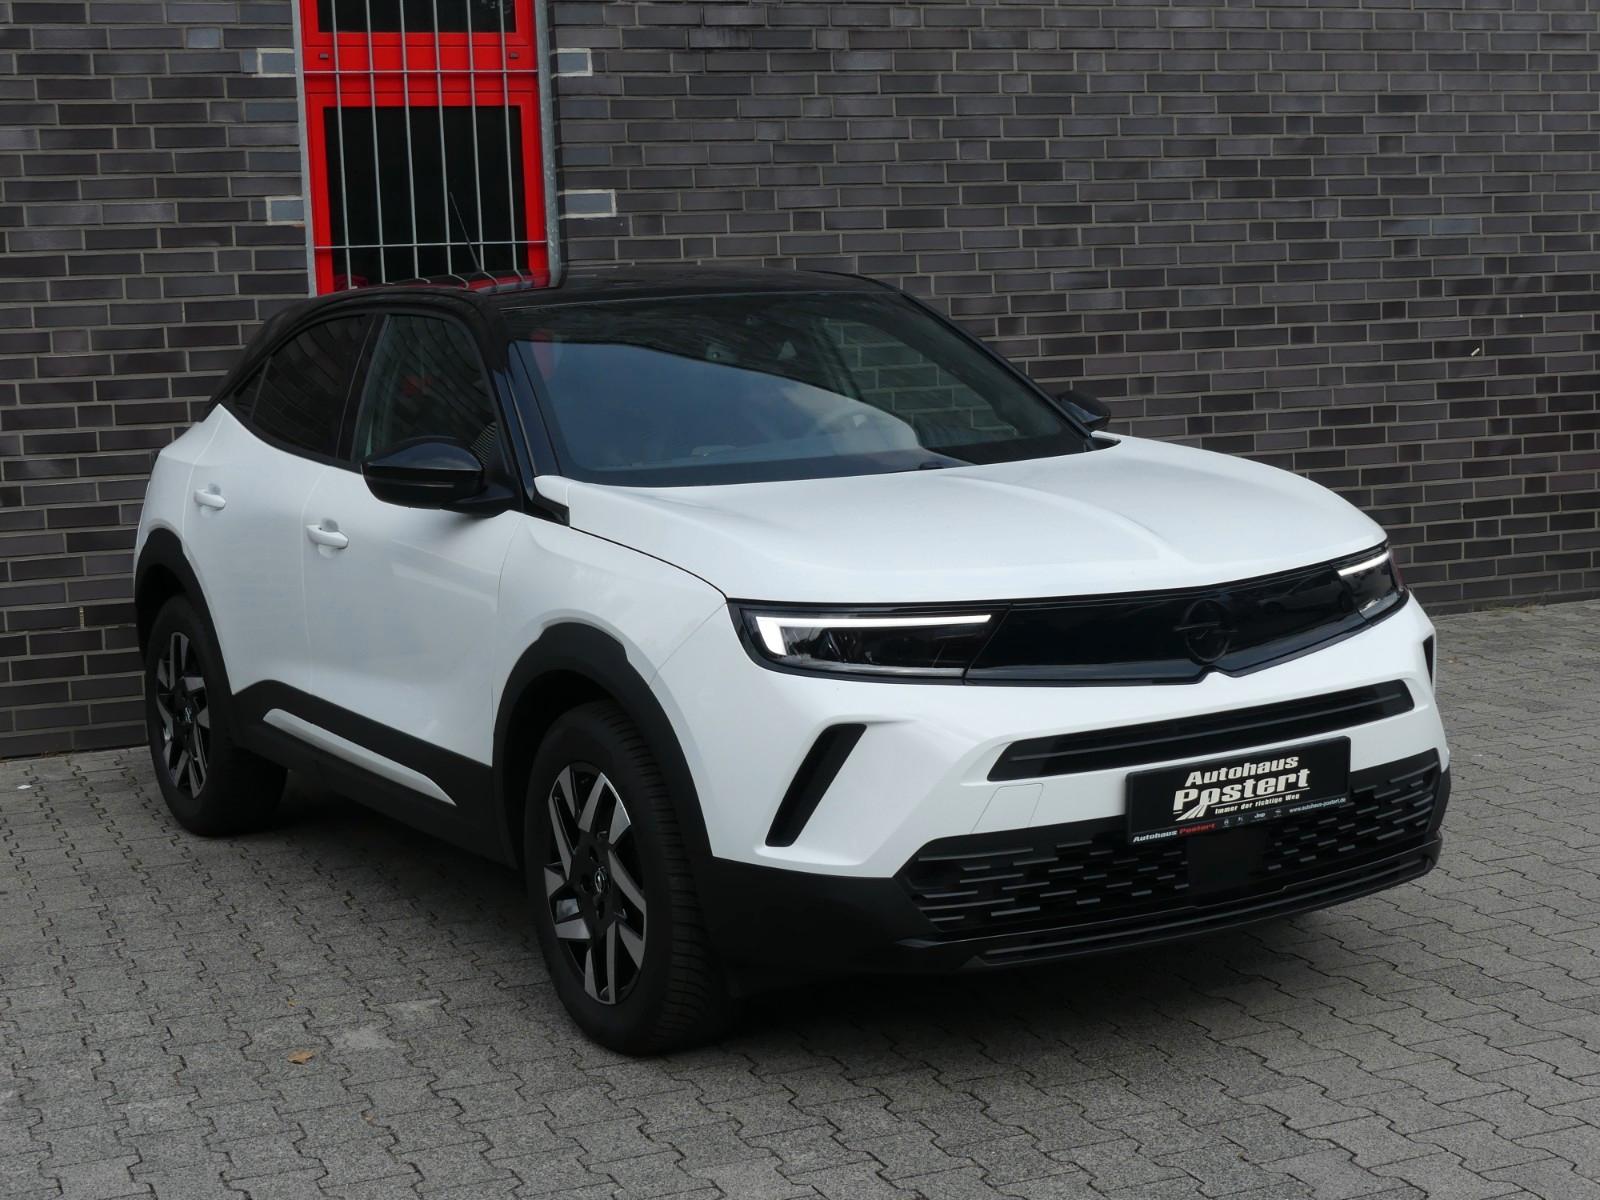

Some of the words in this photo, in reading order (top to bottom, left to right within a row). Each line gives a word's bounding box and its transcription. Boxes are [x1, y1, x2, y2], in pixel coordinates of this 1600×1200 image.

[1184, 756, 1299, 787] Autohaus
[1173, 768, 1310, 814] Postert
[1215, 805, 1238, 815] Immer
[1241, 802, 1253, 810] der
[1255, 797, 1283, 807] richtige
[1285, 793, 1300, 801] Weg
[1133, 830, 1178, 843] Autohaus
[1178, 823, 1217, 835] Postert
